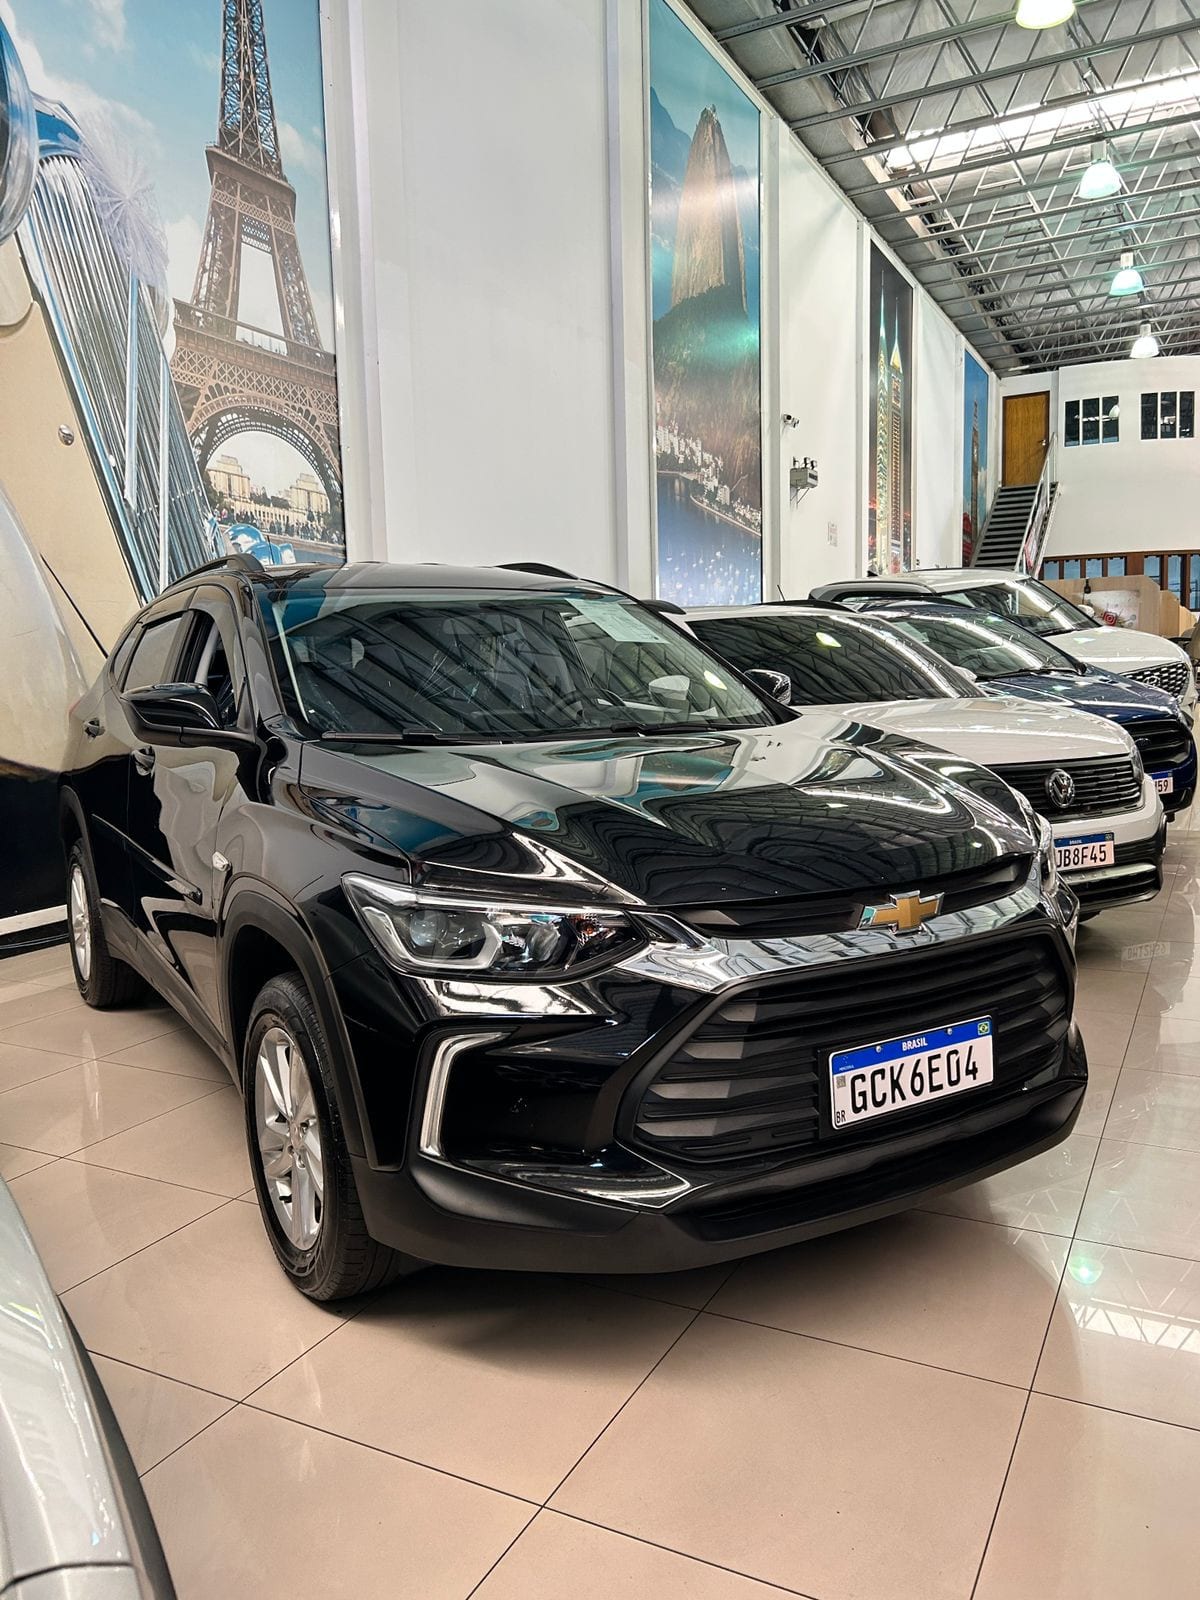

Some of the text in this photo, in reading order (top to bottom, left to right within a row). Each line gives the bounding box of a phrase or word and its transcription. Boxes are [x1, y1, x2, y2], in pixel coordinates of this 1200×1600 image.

[902, 1037, 928, 1052] BRASIL
[850, 1045, 979, 1114] GCK6E04
[835, 1110, 847, 1124] BR
